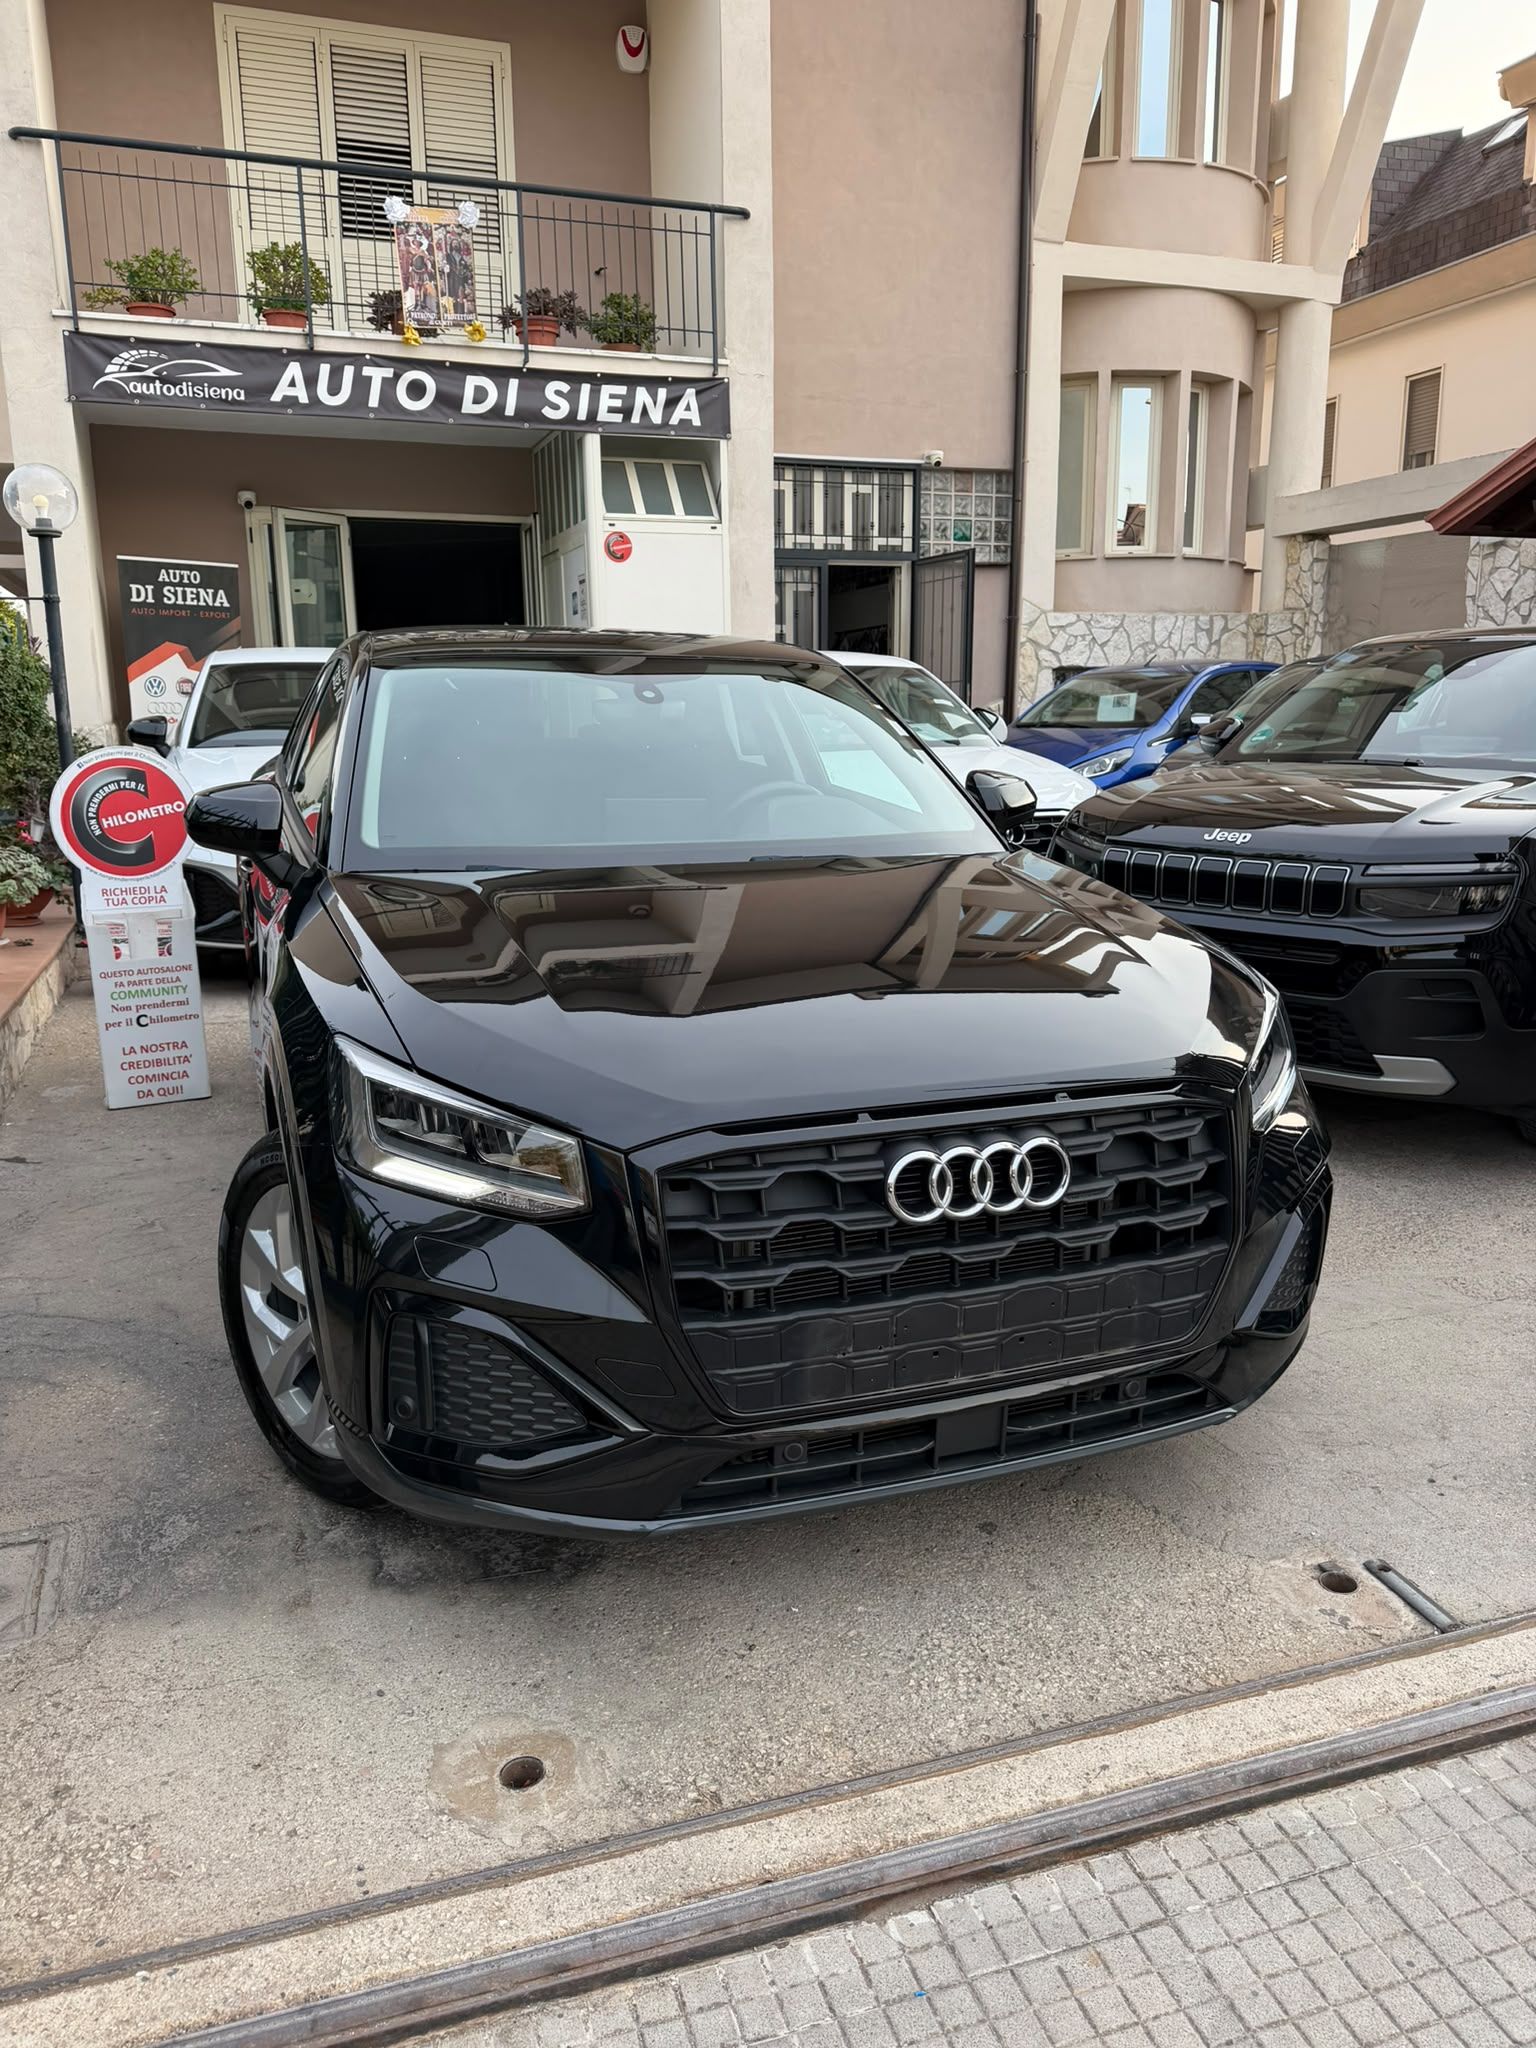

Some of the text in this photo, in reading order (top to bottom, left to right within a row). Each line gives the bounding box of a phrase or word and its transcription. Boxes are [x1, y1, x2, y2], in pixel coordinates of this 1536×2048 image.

[129, 379, 245, 401] autodisiena
[270, 360, 703, 427] AUTO DI SIENA
[157, 568, 201, 584] AUTO
[129, 583, 230, 607] DI SIENA
[131, 608, 157, 616] AUTO
[159, 609, 191, 617] IMPORT
[199, 610, 231, 619] EXPORT
[87, 780, 146, 836] NON PRENDERMI PER IL
[1203, 828, 1252, 845] Jeep
[101, 885, 168, 897] RICHIEDI LA
[104, 895, 167, 907] TUA COPIA
[99, 964, 193, 980] QUESTO AUTOSALONE
[114, 976, 181, 989] FA PARTE DELLA
[110, 984, 188, 1001] COMMUNITY
[111, 998, 190, 1013] Non prendermi
[105, 1021, 123, 1031] per
[125, 1018, 133, 1026] il
[122, 1040, 188, 1056] LA NOSTRA
[120, 1054, 193, 1071] CREDIBILITA'
[128, 1070, 190, 1085] COMINCIA
[137, 1085, 184, 1099] DA QUI!
